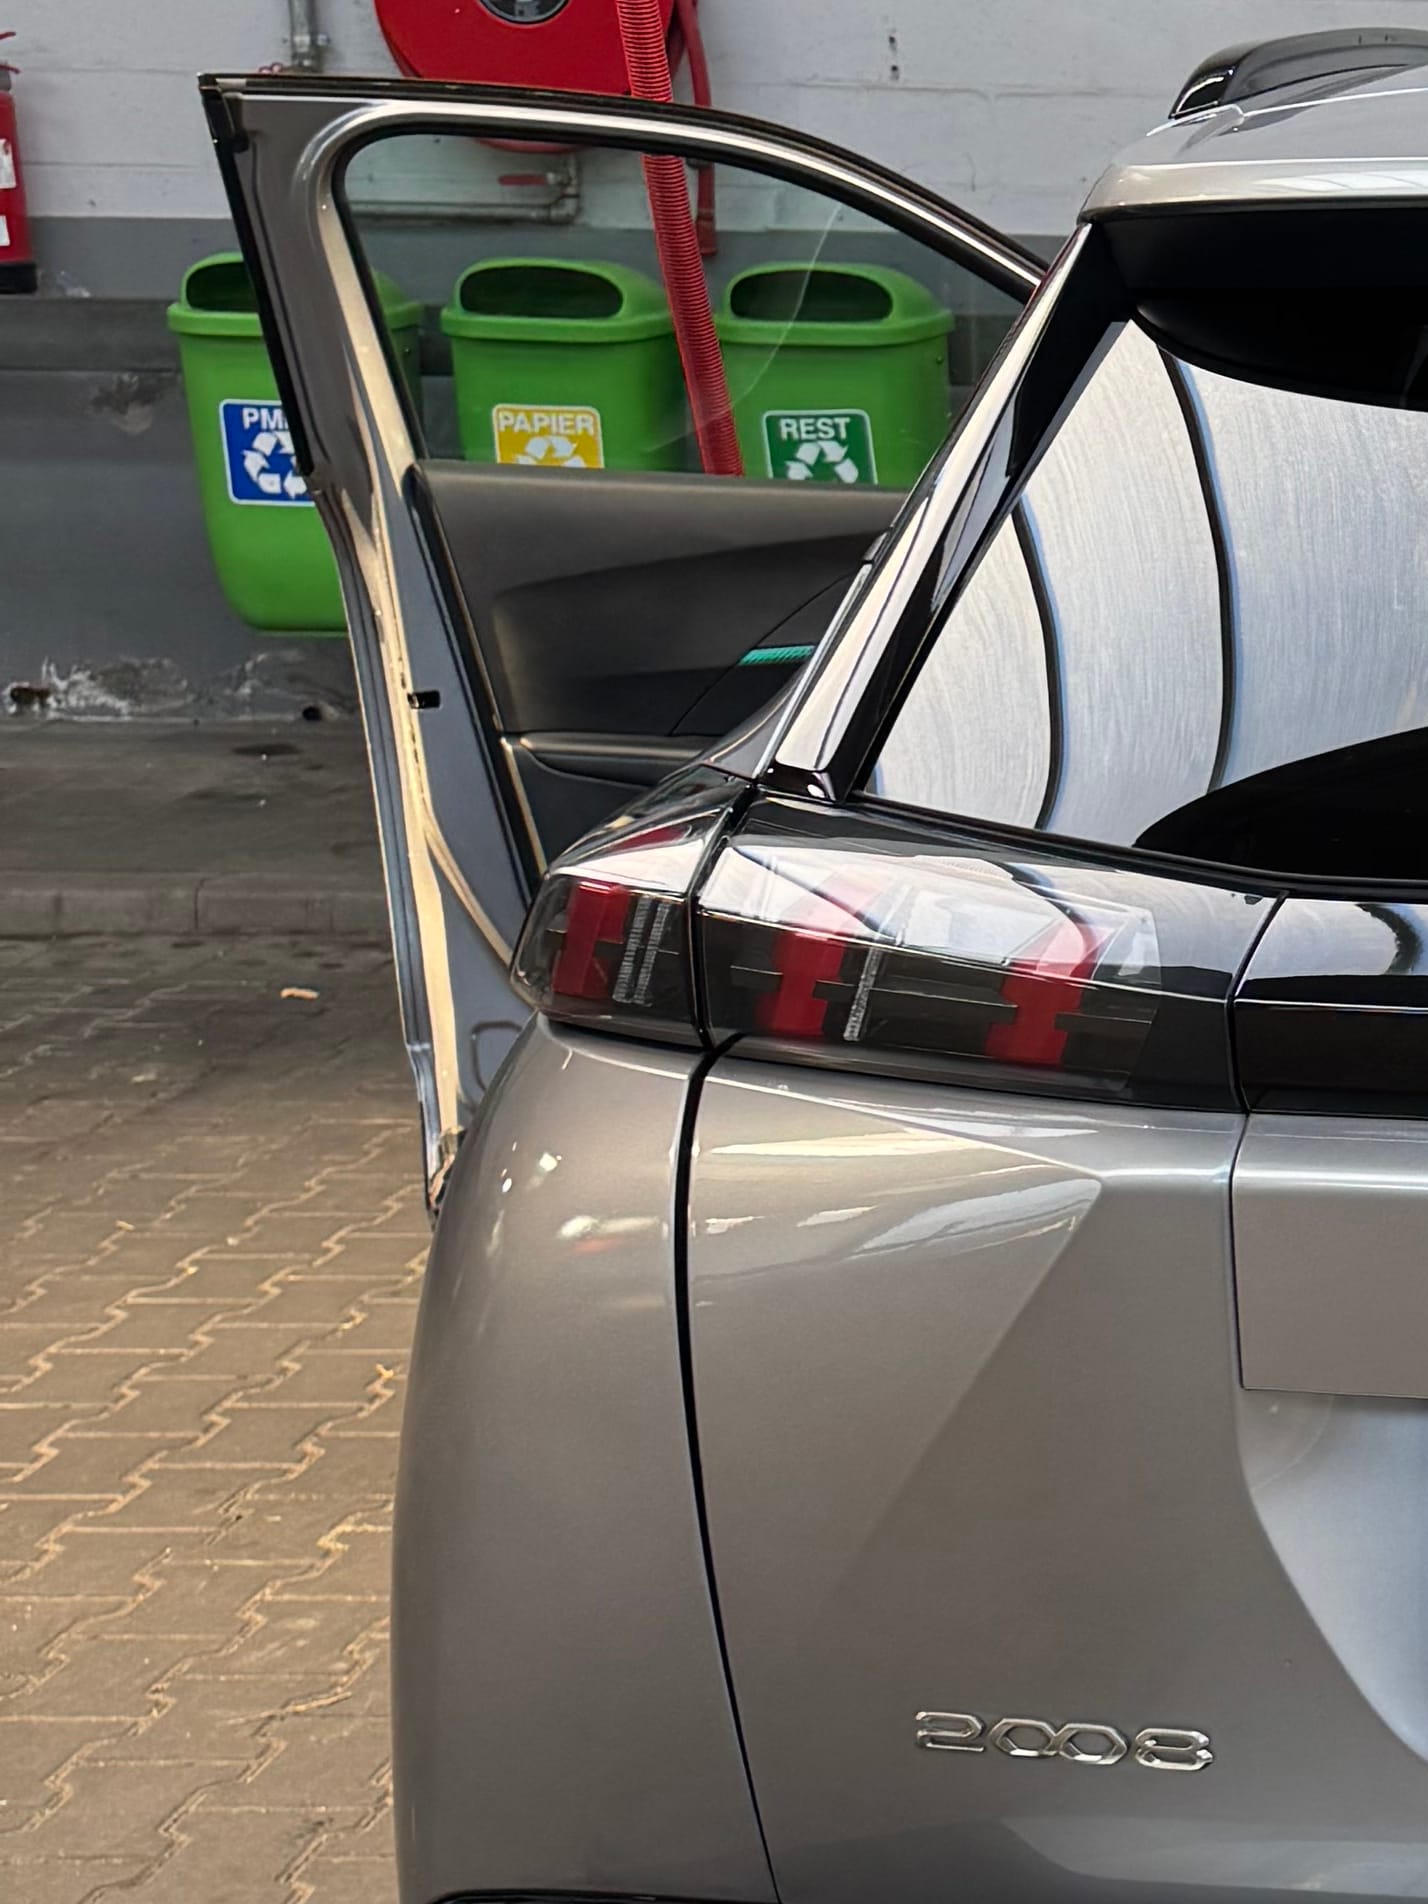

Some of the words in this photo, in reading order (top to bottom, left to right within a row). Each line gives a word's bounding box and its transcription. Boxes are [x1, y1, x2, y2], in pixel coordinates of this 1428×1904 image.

[242, 407, 290, 430] PM
[498, 411, 595, 436] PAPIER
[780, 416, 851, 441] REST
[914, 1710, 1215, 1772] 2008
